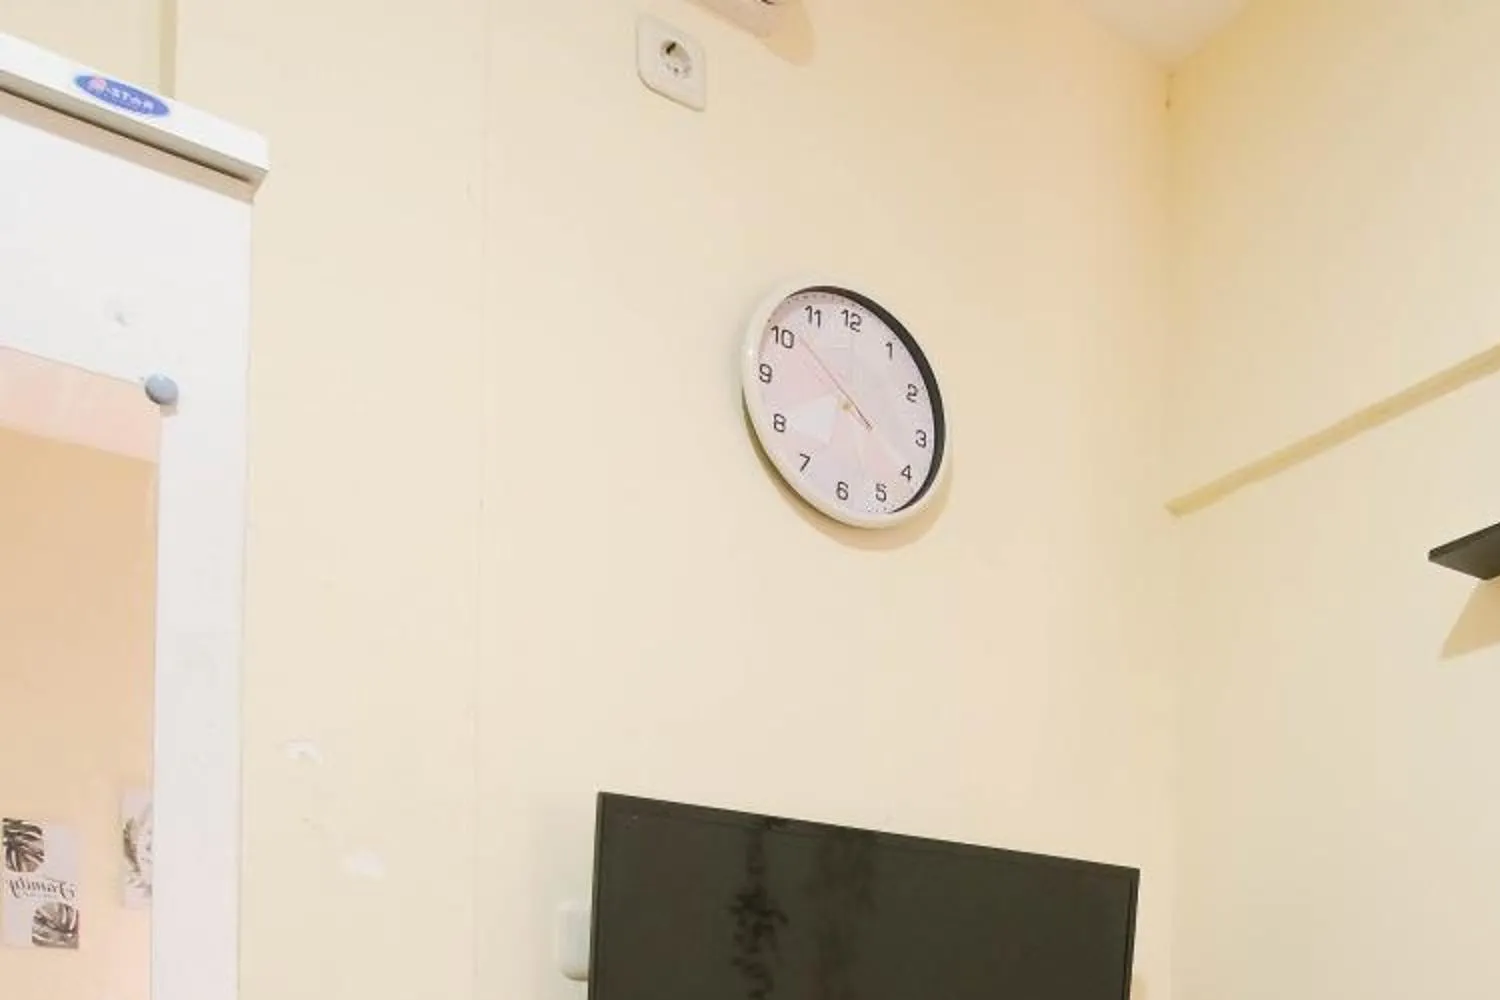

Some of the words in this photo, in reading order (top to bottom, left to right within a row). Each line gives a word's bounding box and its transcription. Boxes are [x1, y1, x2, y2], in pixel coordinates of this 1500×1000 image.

[805, 304, 822, 328] 11
[841, 309, 862, 333] 12
[771, 325, 795, 350] 10
[886, 342, 893, 361] 1
[759, 363, 773, 384] 9
[906, 384, 918, 403] 2
[773, 413, 787, 433] 8
[915, 429, 928, 449] 3
[799, 453, 811, 473] 7
[901, 465, 913, 481] 4
[836, 481, 849, 501] 6
[875, 483, 888, 502] 5
